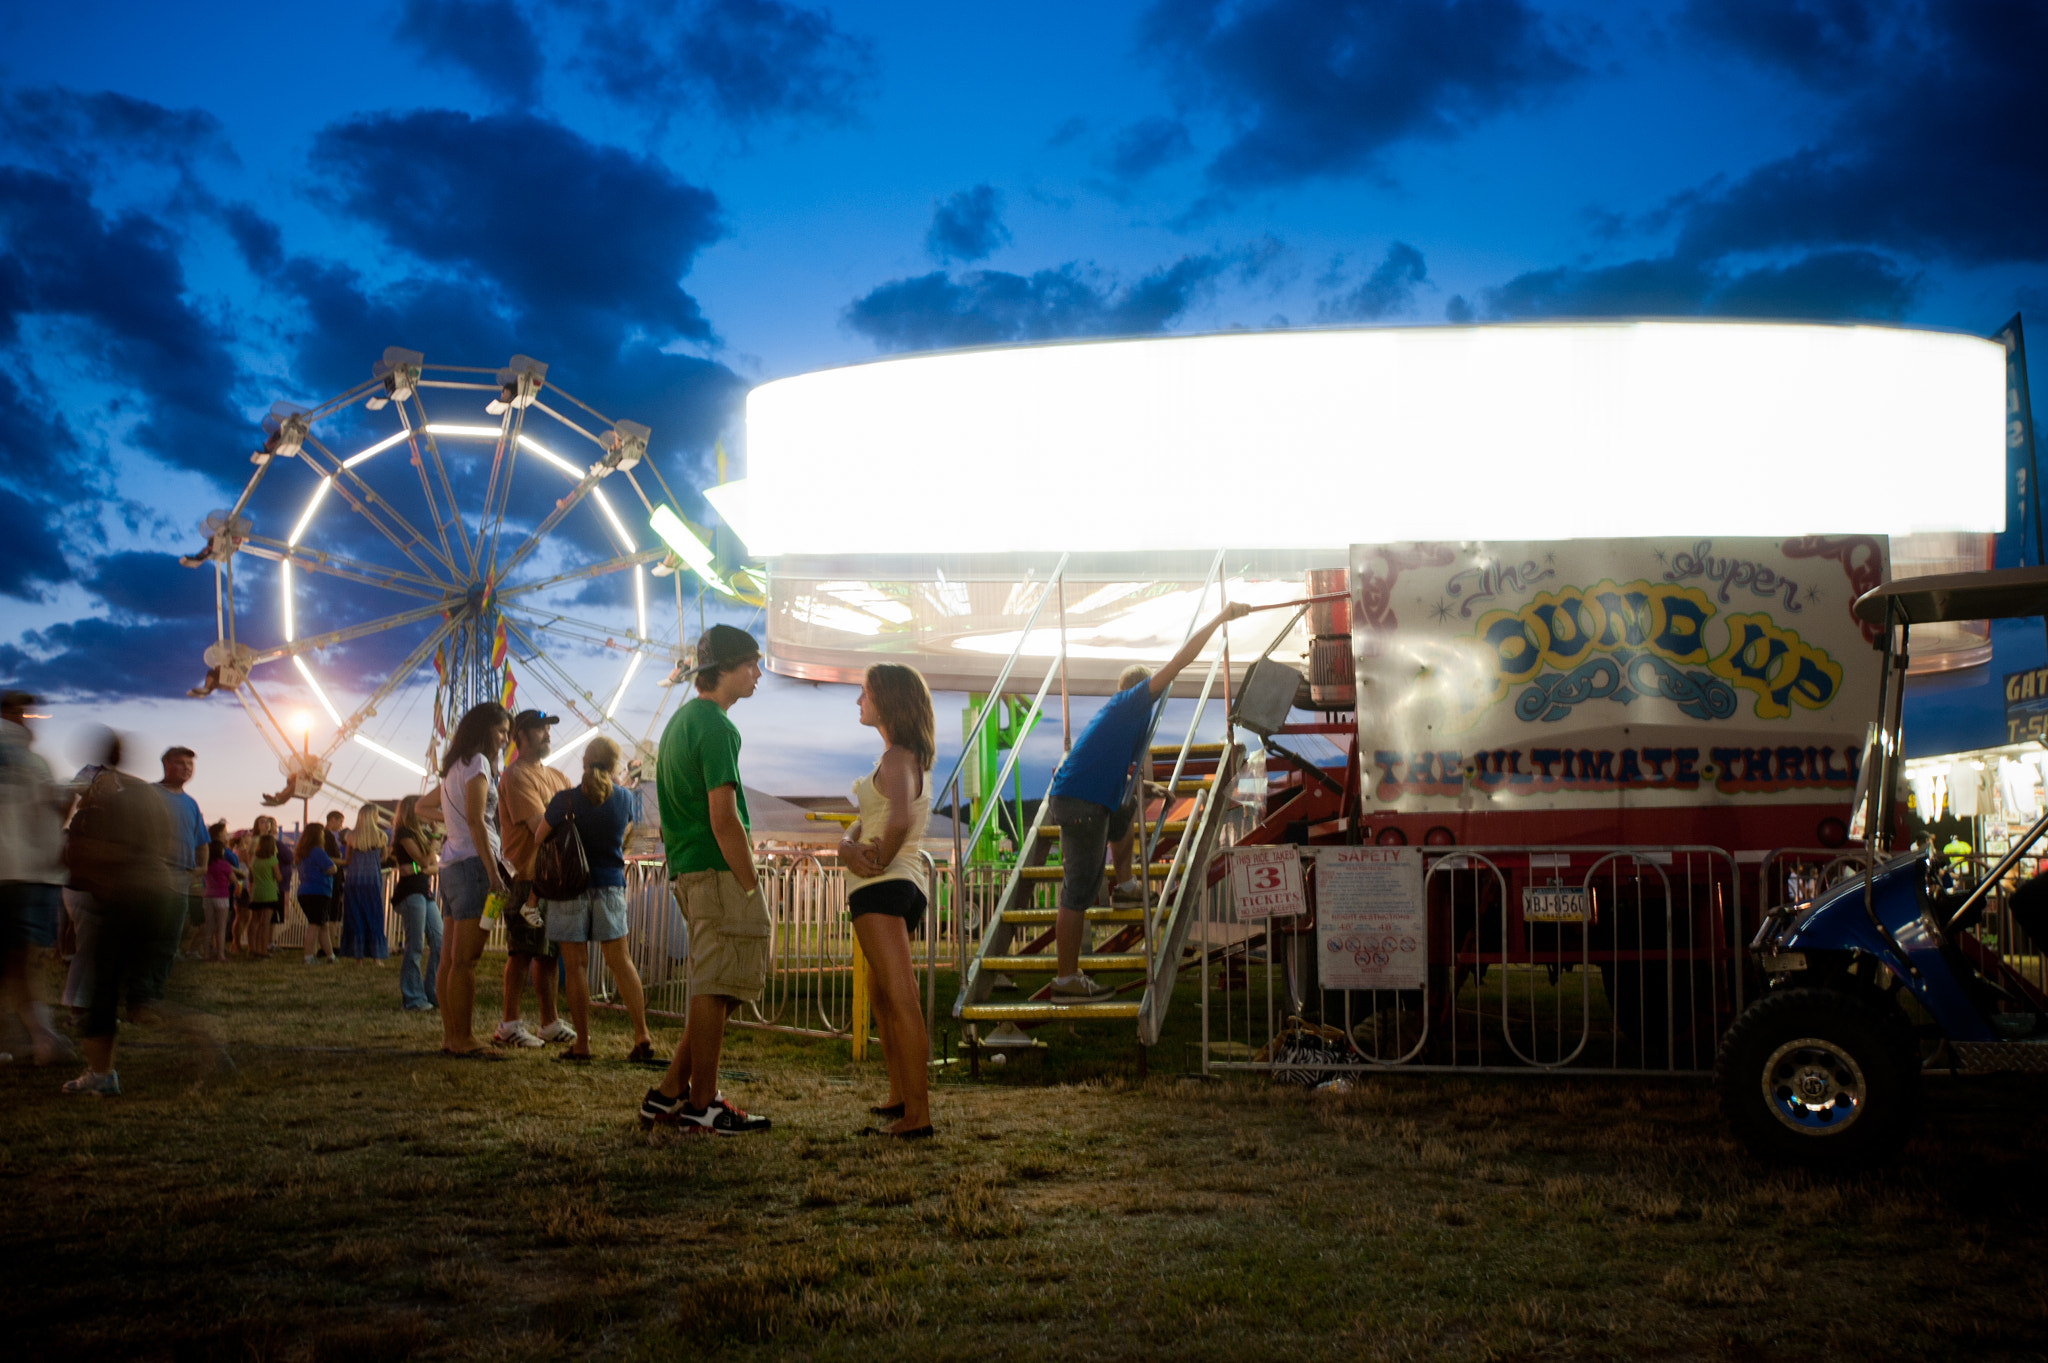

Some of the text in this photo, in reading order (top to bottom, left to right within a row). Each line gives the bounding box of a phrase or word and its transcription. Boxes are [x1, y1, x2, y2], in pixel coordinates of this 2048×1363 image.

[1446, 539, 1803, 618] The Super
[1436, 577, 1843, 737] OUND UP
[1374, 748, 1464, 801] THE
[1472, 745, 1700, 798] ULTIMATE
[1236, 850, 1295, 865] THIS RIDE TAKES
[1337, 849, 1401, 863] SAFETY
[1254, 866, 1281, 889] 3
[1240, 892, 1300, 907] TICKETS
[1251, 905, 1268, 914] CASH
